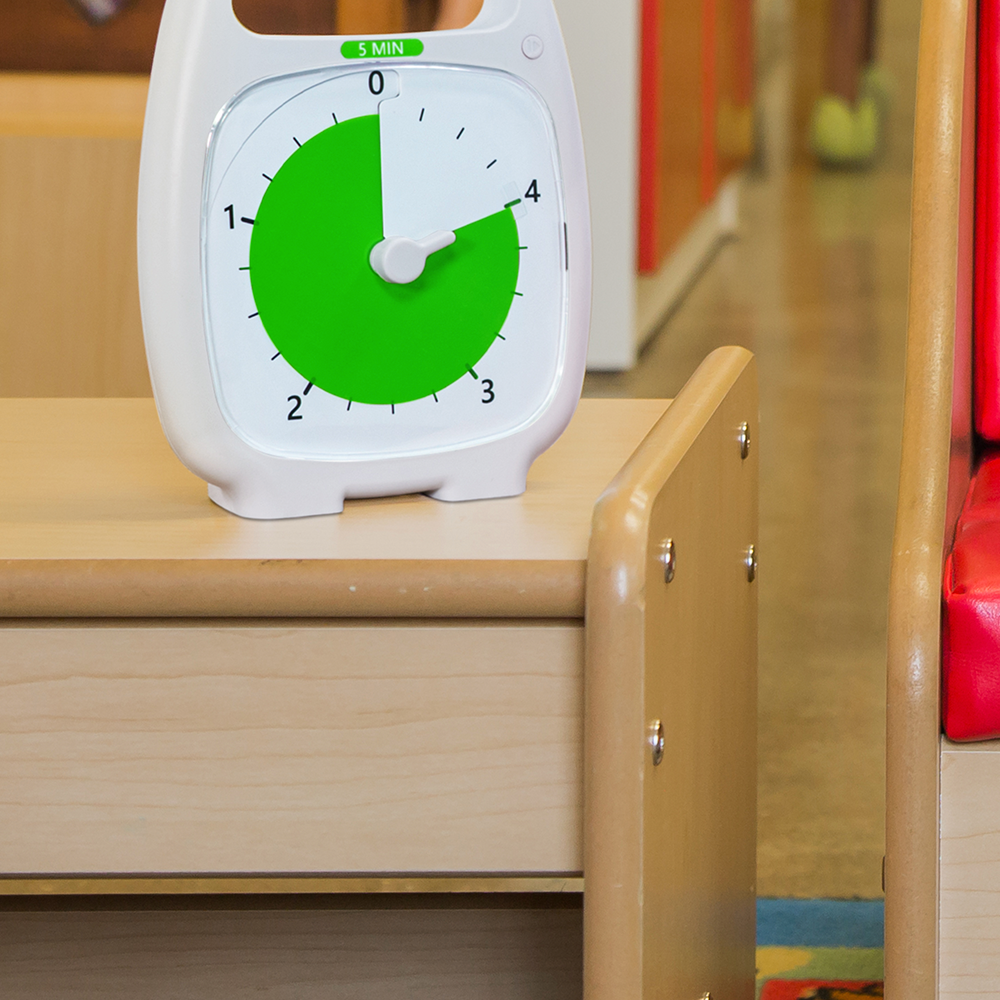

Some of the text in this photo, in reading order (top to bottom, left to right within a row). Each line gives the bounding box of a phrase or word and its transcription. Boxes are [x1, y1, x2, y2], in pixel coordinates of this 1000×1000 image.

[358, 41, 404, 56] 5 MIN
[368, 70, 384, 95] 0
[524, 179, 541, 202] 4
[224, 204, 235, 229] 1
[481, 379, 495, 403] 3
[287, 395, 303, 420] 2
